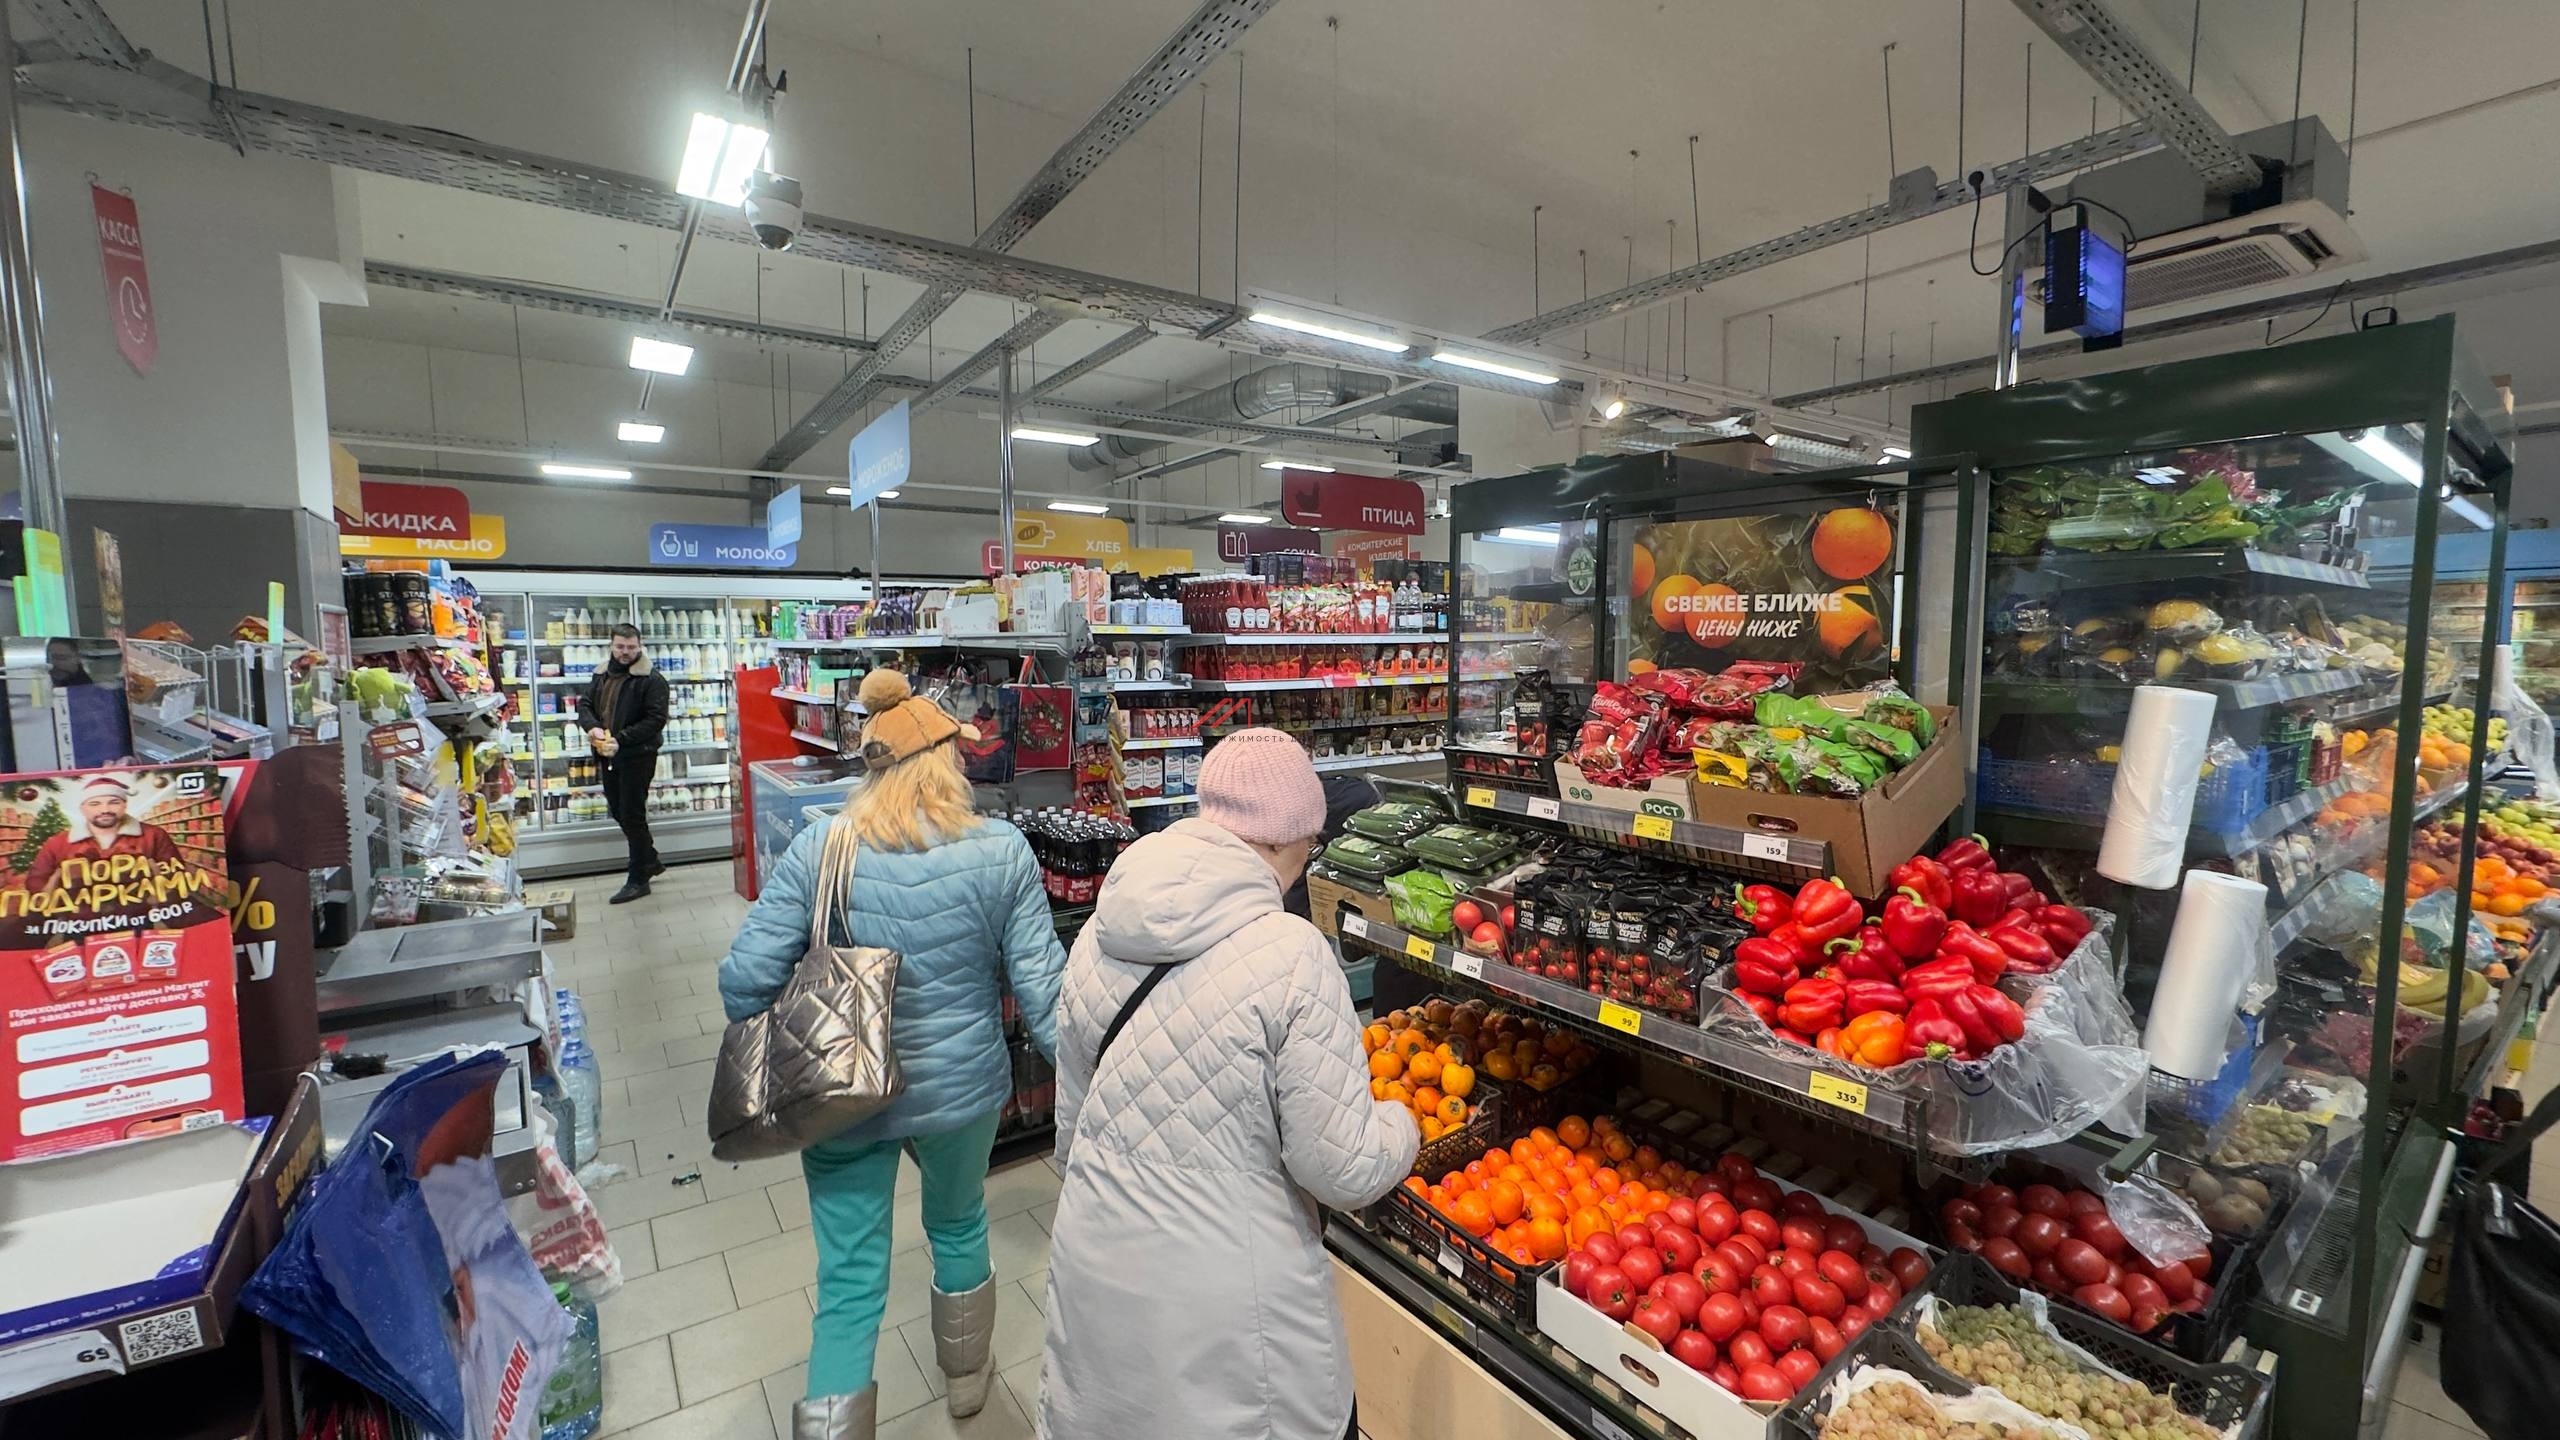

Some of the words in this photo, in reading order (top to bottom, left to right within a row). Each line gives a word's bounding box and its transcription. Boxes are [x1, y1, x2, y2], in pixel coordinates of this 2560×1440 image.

[99, 215, 141, 248] КАССА
[1361, 506, 1416, 527] ПТИЦА
[415, 538, 493, 552] МАСЛО
[1085, 540, 1122, 552] ХЛЕБ
[1347, 536, 1404, 552] КОНДИТЕРСКИЕ
[715, 546, 787, 561] МОЛОКО
[1368, 550, 1404, 562] ИЗДЕЛИЯ
[1664, 594, 1748, 613] СВЕЖЕЕ
[1754, 593, 1842, 613] БЛИЖЕ
[1695, 620, 1745, 640] ЦЕНЫ
[1746, 619, 1801, 638] НИЖЕ
[1645, 802, 1679, 817] РОСТ
[1766, 847, 1781, 856] 159
[60, 855, 151, 889] ПОРА
[157, 857, 185, 875] ЗА
[0, 868, 212, 918] ПОДАРКАМИ
[43, 914, 128, 935] ПОКУПКИ
[9, 999, 85, 1019] Приходите
[99, 987, 163, 1005] магазины
[164, 979, 210, 994] Магнит
[9, 1019, 37, 1028] или
[39, 1002, 127, 1023] заказывайте
[129, 993, 188, 1009] доставку
[1622, 1017, 1633, 1027] 99
[1836, 1090, 1857, 1104] 339
